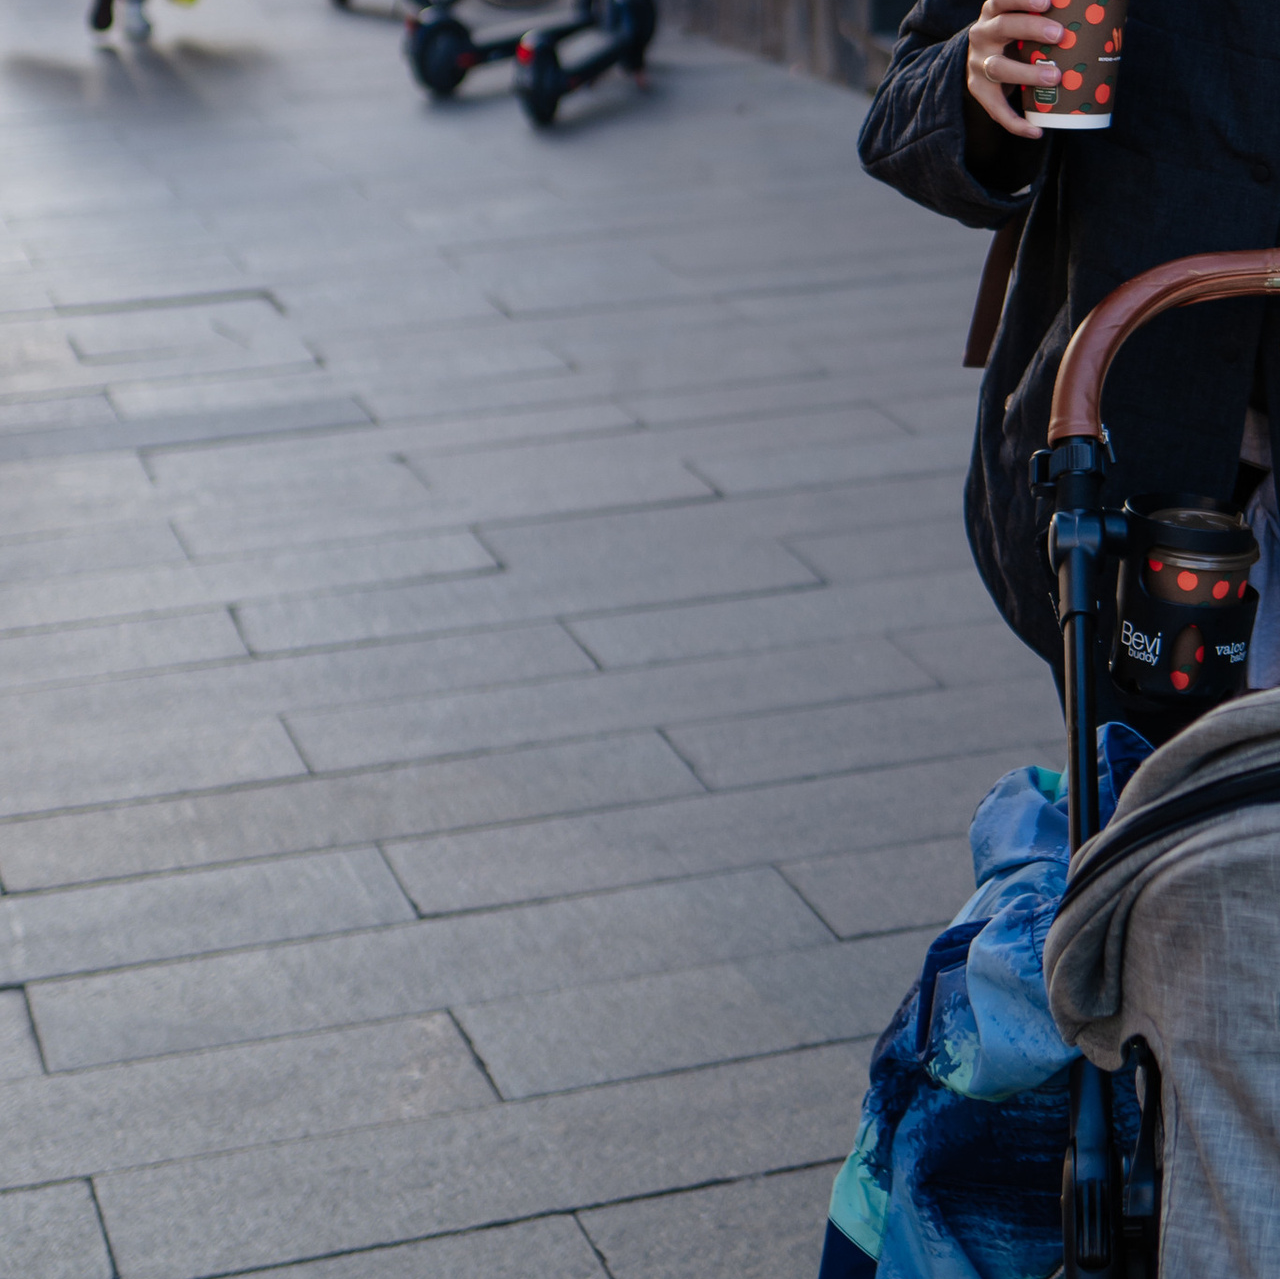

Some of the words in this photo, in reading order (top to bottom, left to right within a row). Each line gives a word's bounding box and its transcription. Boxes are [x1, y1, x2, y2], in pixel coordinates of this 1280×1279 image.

[1120, 619, 1162, 656] Bevi
[1127, 646, 1159, 667] buddy
[1215, 641, 1247, 656] valco
